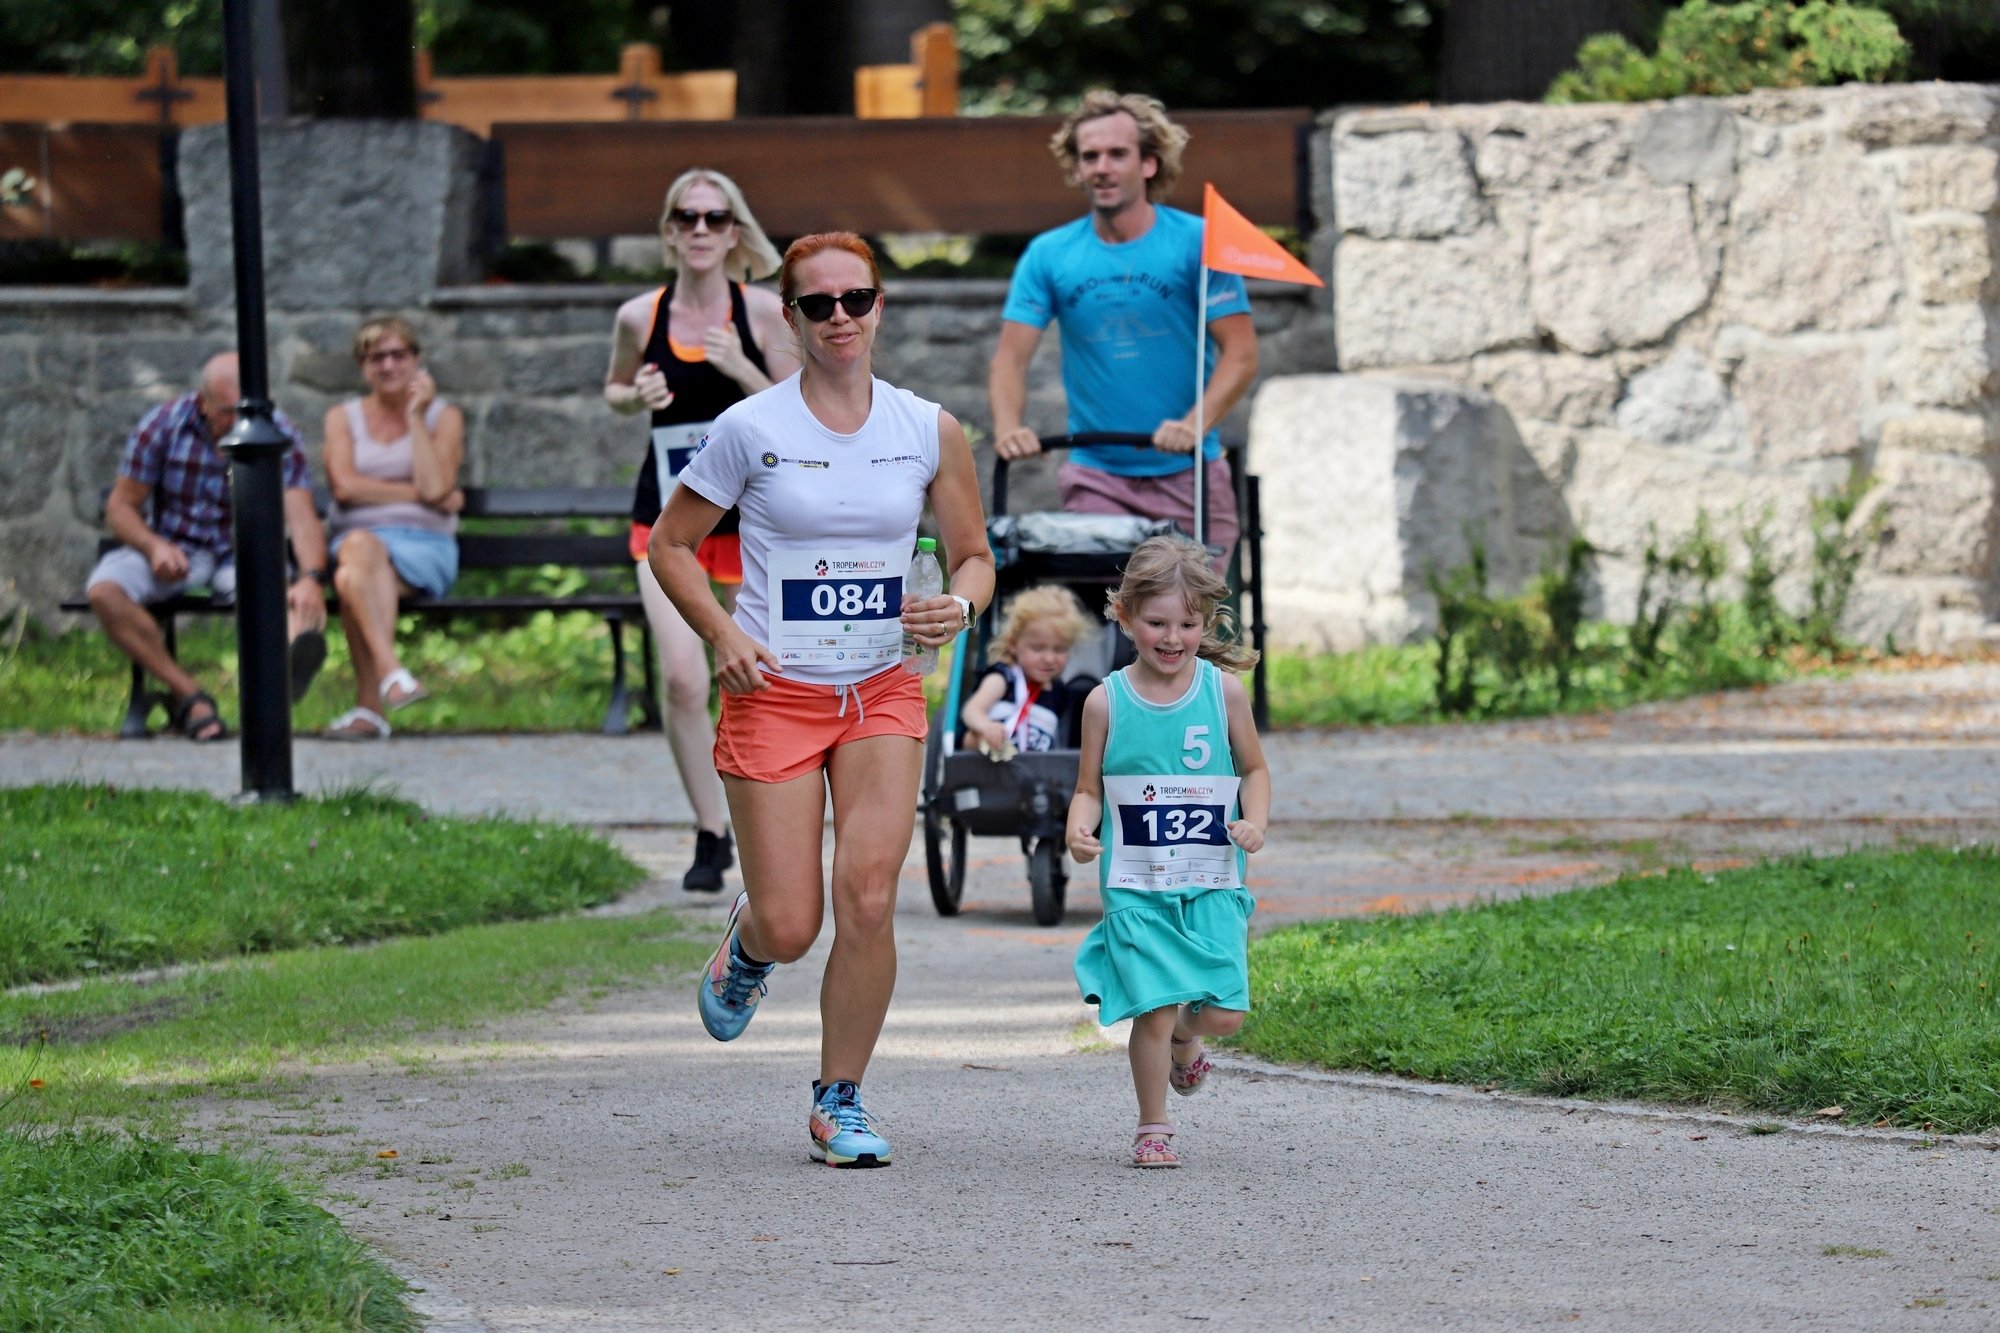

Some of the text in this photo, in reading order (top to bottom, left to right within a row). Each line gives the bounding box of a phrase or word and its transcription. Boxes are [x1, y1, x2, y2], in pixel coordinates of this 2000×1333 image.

[811, 583, 887, 616] 084
[1181, 724, 1212, 770] 5
[1142, 809, 1214, 842] 132
